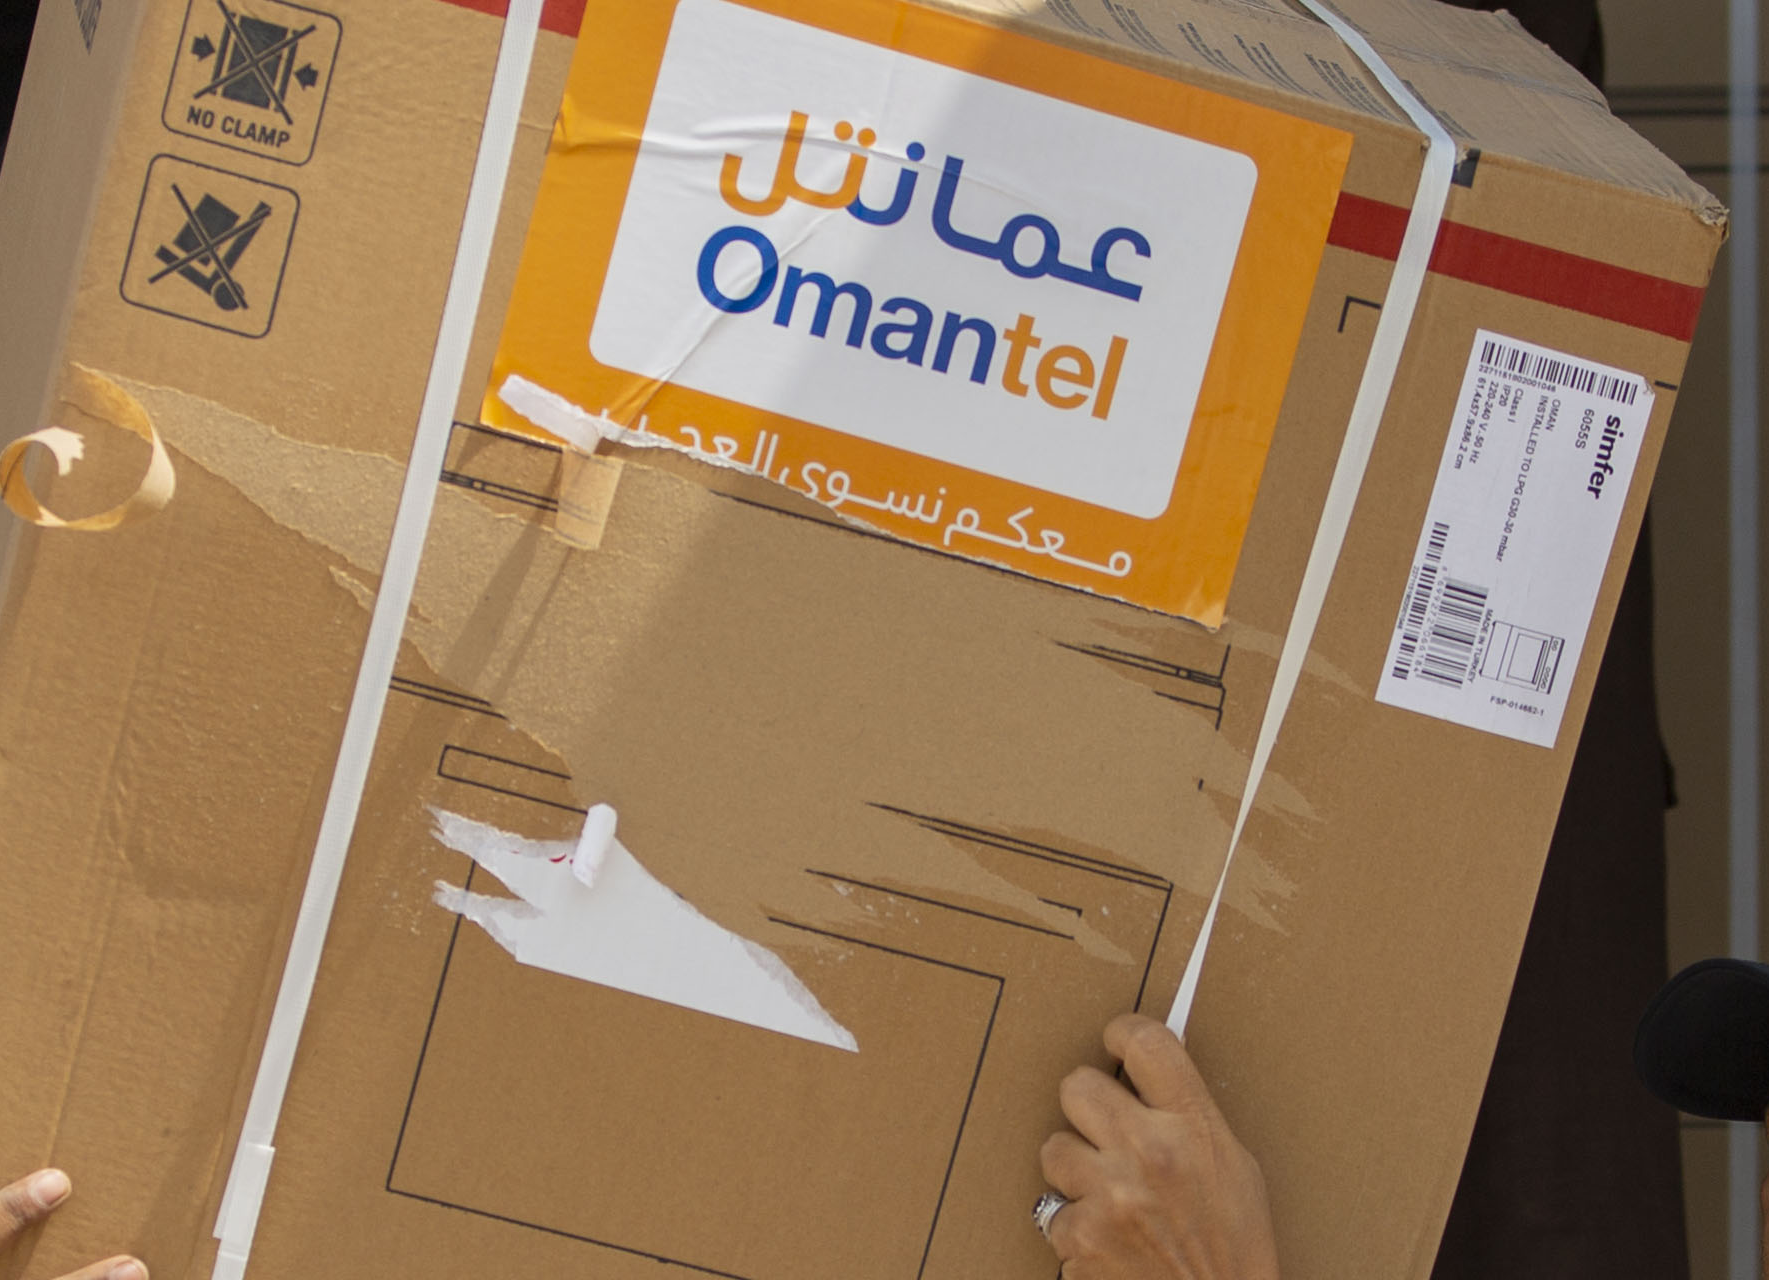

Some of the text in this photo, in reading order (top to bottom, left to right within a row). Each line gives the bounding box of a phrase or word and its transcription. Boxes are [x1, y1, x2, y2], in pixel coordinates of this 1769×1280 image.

[186, 105, 291, 148] NO CLAMP
[718, 110, 1153, 303] عمانتل
[696, 224, 1130, 421] Omantel
[1497, 383, 1512, 408] IP20
[1508, 387, 1525, 417] Class
[1524, 394, 1550, 456] INSTALLED
[1544, 398, 1562, 432] OMAN
[1574, 408, 1596, 450] 6055S
[1453, 453, 1465, 470] cm
[1468, 449, 1481, 465] Hz
[1520, 457, 1533, 473] TO
[1586, 414, 1625, 501] simfer
[1513, 473, 1528, 496] LPG
[942, 506, 1133, 578] معكم
[1495, 534, 1509, 563] mbar
[1480, 608, 1494, 635] MADE
[1466, 647, 1484, 684] TURKEY
